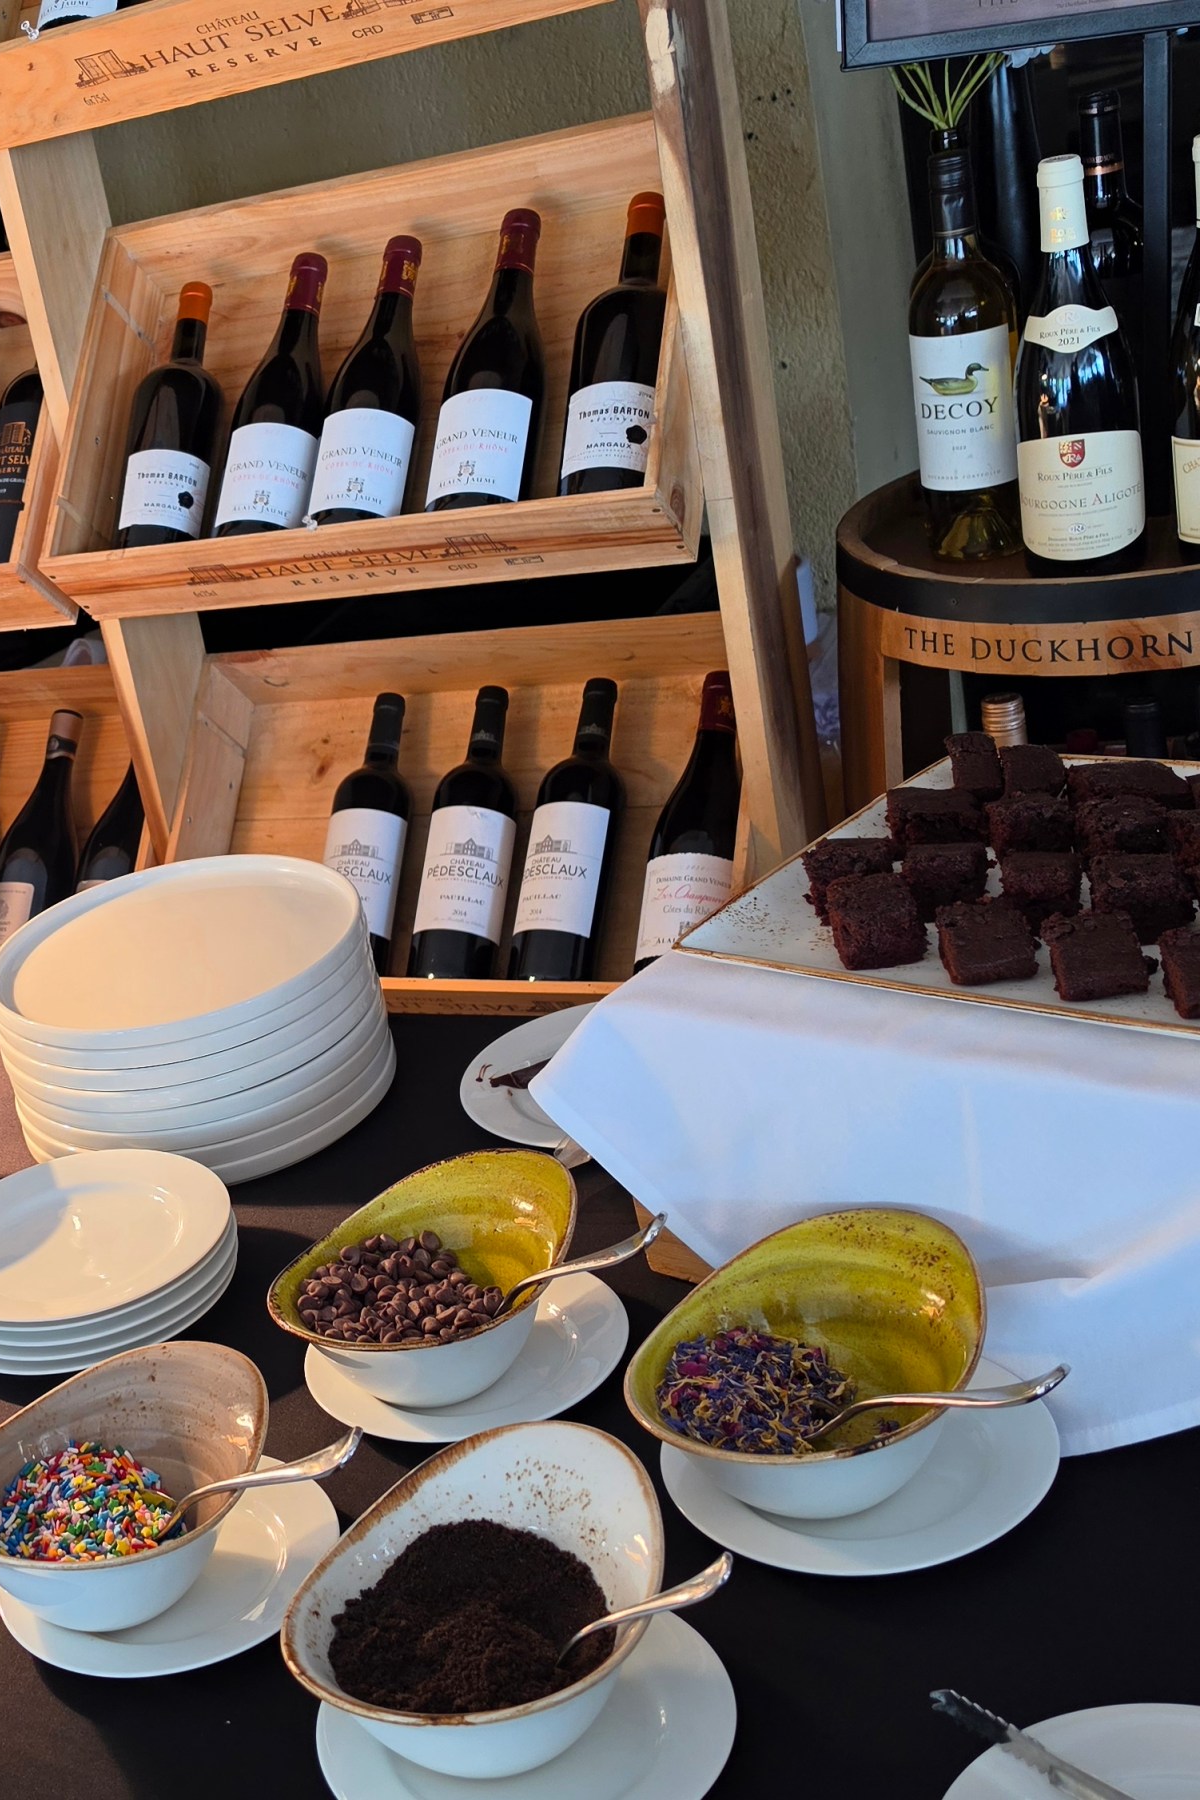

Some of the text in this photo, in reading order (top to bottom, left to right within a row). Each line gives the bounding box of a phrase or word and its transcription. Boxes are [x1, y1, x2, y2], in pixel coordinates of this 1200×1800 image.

[196, 11, 260, 35] CHÂTEAU
[141, 4, 340, 69] HAUT SELVE
[351, 24, 384, 39] CRD
[186, 36, 322, 78] RESERVE
[1057, 336, 1081, 347] 2021
[579, 406, 651, 421] Thomas BARTON
[921, 396, 998, 420] DECOY
[926, 423, 995, 436] SAUVIGNON BLANC
[436, 428, 518, 450] GRAND VENEUR
[585, 441, 632, 450] MARGAUX
[478, 443, 508, 454] RHÔNE
[322, 446, 403, 468] GRAND VENEUR
[229, 460, 309, 481] GRAND VENEUR
[367, 462, 394, 476] RHÔNE
[1037, 471, 1061, 482] ROUX
[1086, 470, 1093, 478] &
[1095, 466, 1113, 477] FILS
[137, 472, 198, 488] Thomas BARTON
[273, 475, 300, 490] RHÔNE
[465, 475, 495, 486] JAUME
[355, 493, 383, 505] JAUME
[144, 502, 182, 512] MARGAUX
[259, 505, 290, 518] JAUME
[252, 549, 441, 579] HAUT SELVE
[448, 562, 479, 572] CRD
[290, 567, 420, 586] RESERVE
[904, 626, 1194, 663] THE DUCKHORN
[337, 859, 371, 868] CHÂTEAU
[449, 858, 486, 870] CHÂTEAU
[531, 856, 562, 865] CHÂTEAU
[335, 866, 393, 885] ESCLAUX
[426, 864, 505, 890] PÉDESCLAUX
[524, 863, 588, 880] DESCLAUX
[655, 876, 682, 885] DOMAINE
[683, 874, 709, 884] GRAND
[439, 894, 486, 906] PAUILLAC
[452, 908, 468, 918] 2014
[662, 902, 711, 916] Côtes du Rhô
[655, 937, 676, 945] ALAI
